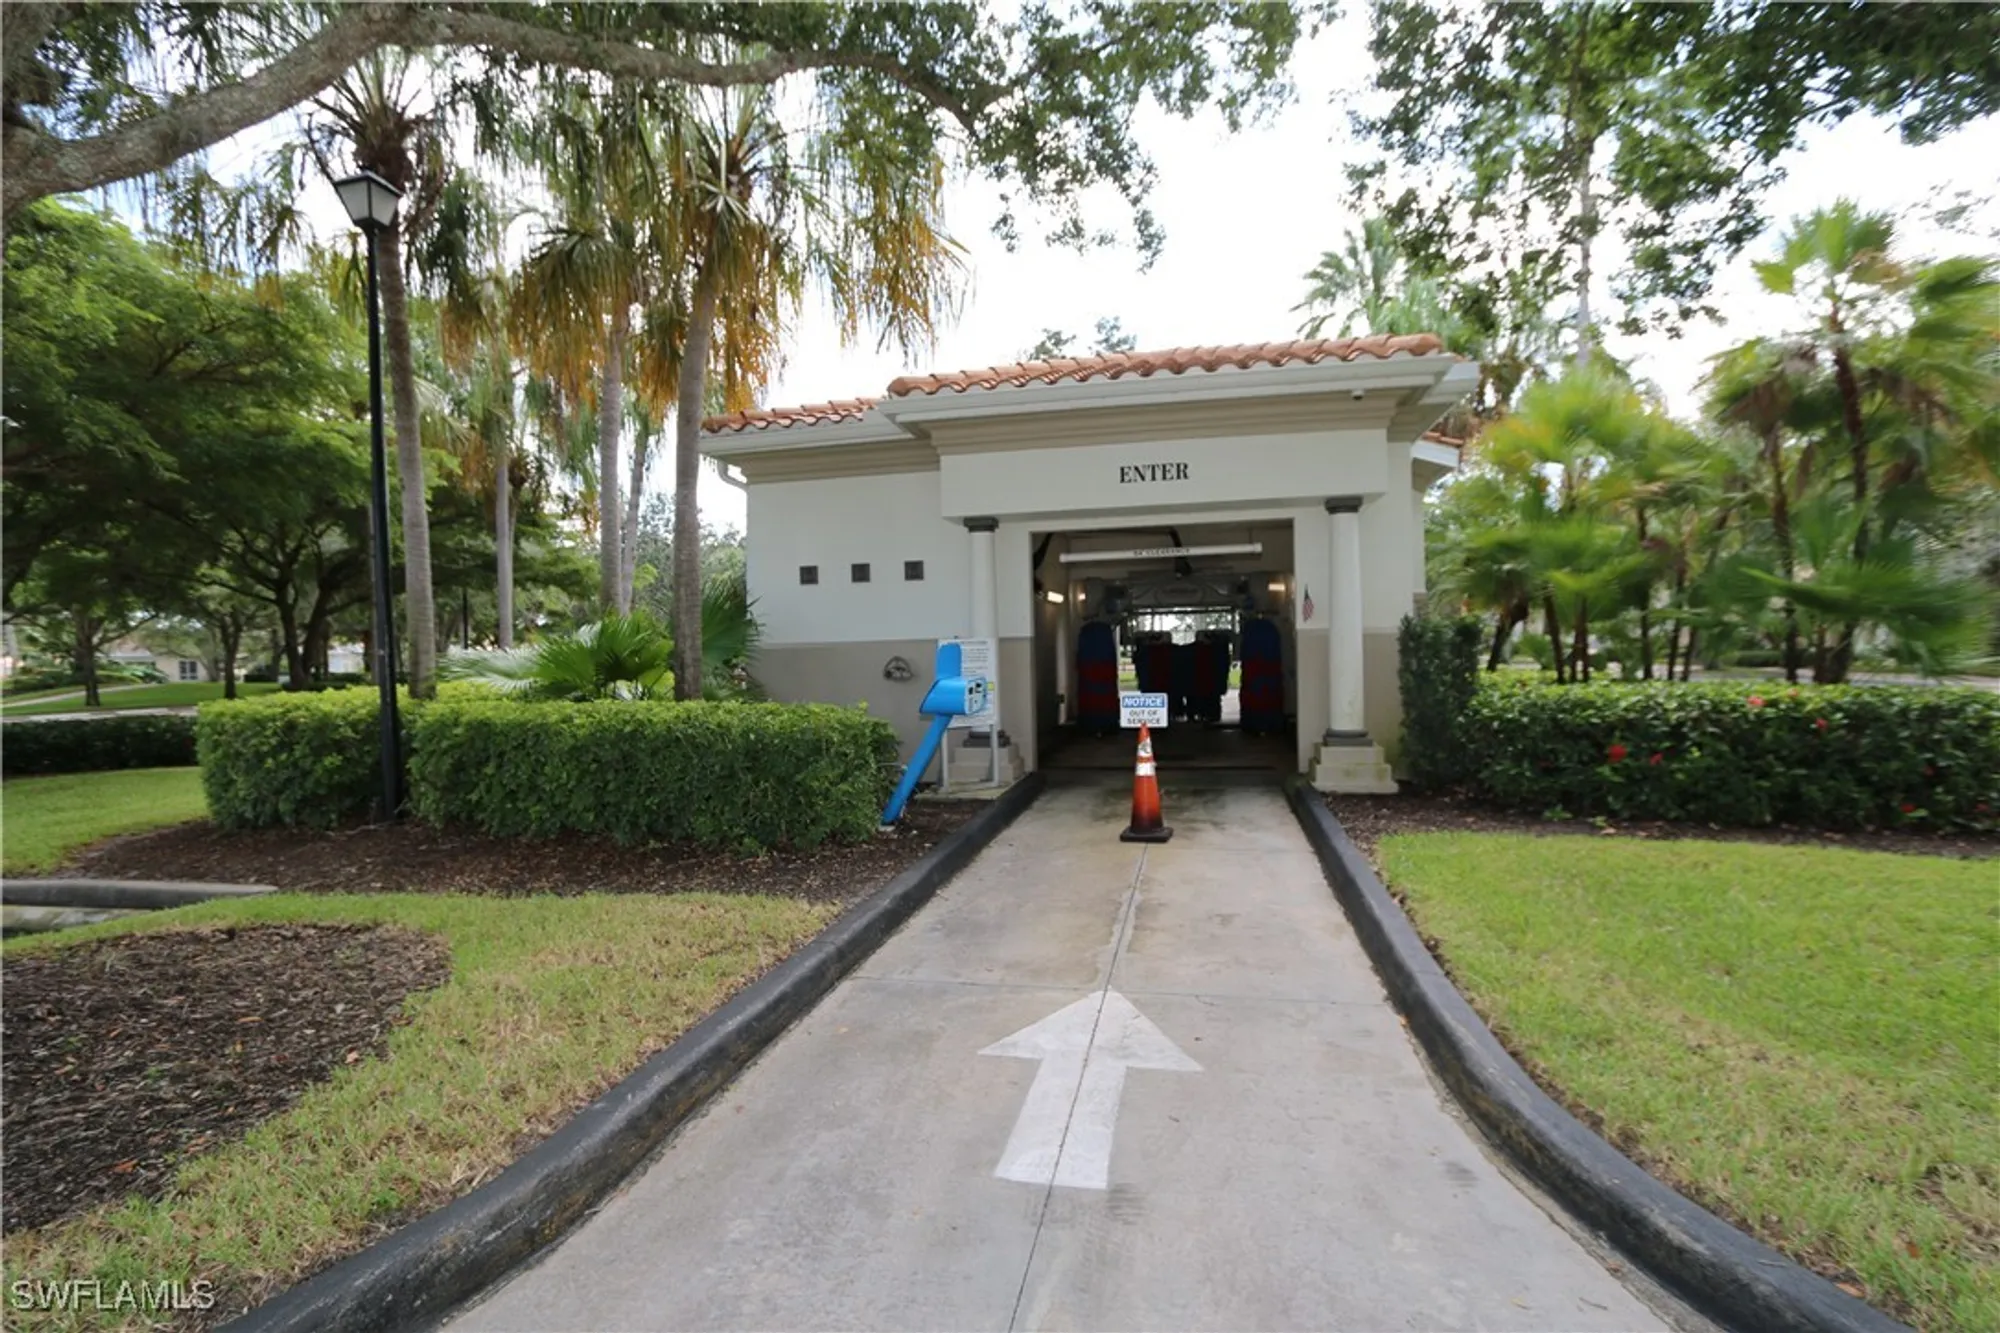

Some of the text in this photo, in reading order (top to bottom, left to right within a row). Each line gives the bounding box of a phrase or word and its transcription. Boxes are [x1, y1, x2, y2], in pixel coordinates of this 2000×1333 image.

[1119, 462, 1189, 484] ENTER
[1124, 698, 1163, 707] NOTICE
[1129, 709, 1157, 717] OUT OF
